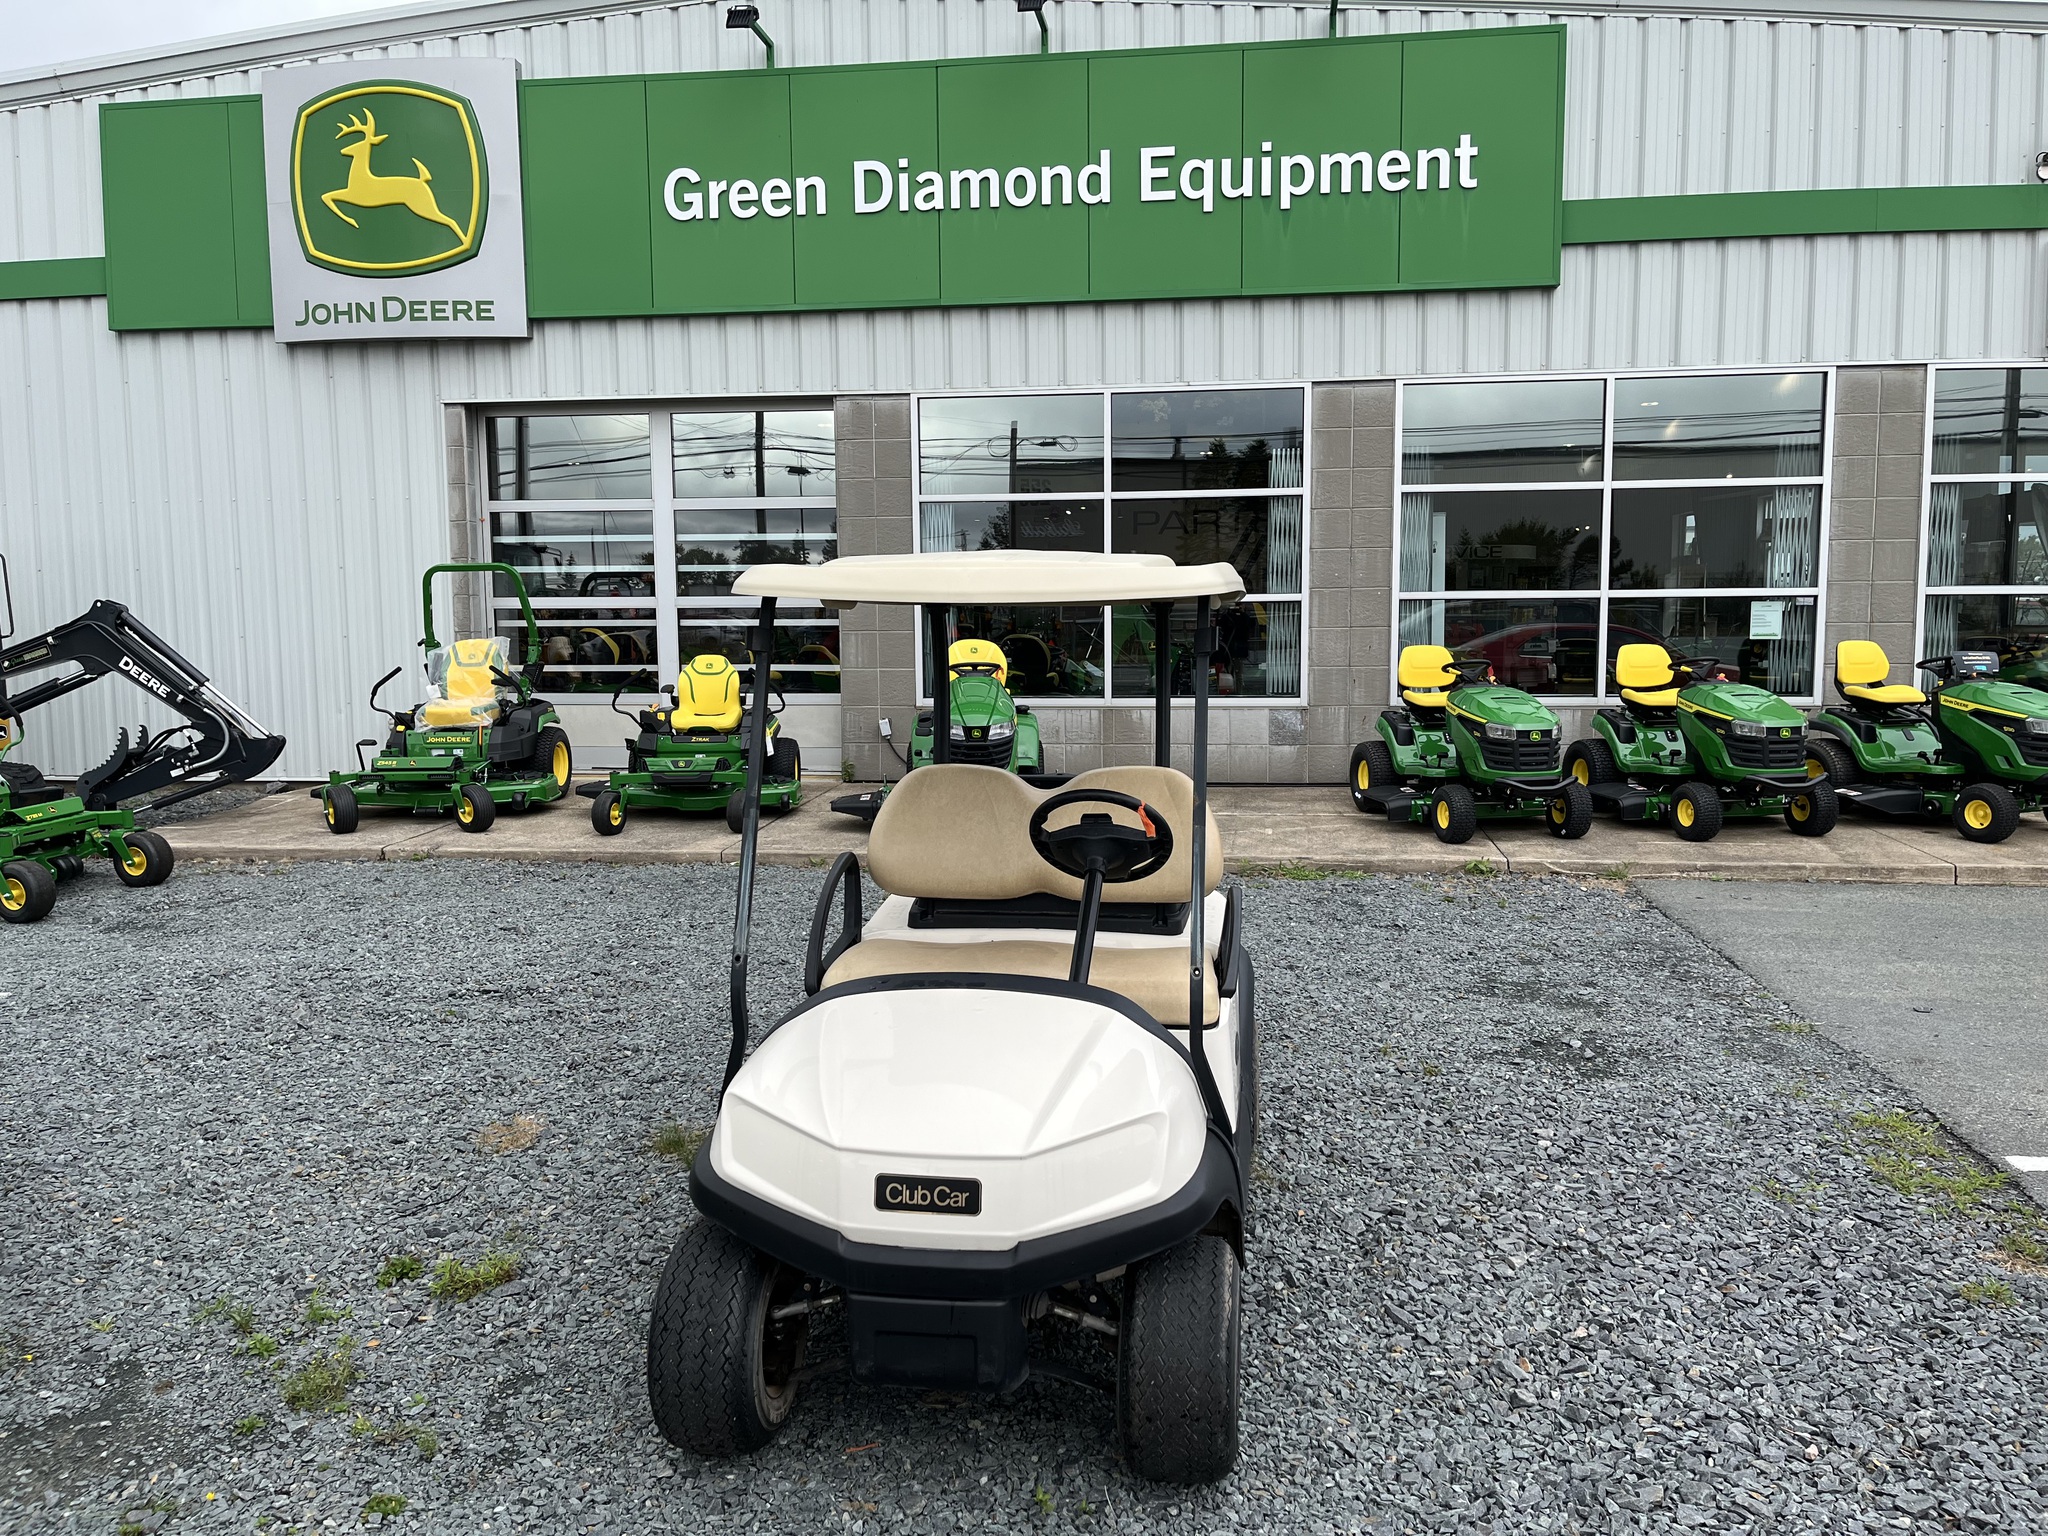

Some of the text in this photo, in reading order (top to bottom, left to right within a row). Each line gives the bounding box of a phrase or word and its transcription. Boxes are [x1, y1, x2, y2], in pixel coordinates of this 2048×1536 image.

[664, 135, 1478, 220] Green Diamond Equipment
[295, 296, 495, 326] JOHN DEERE
[118, 655, 171, 698] DEERE
[1954, 700, 1969, 708] DEERE
[885, 1182, 970, 1207] Club Car
